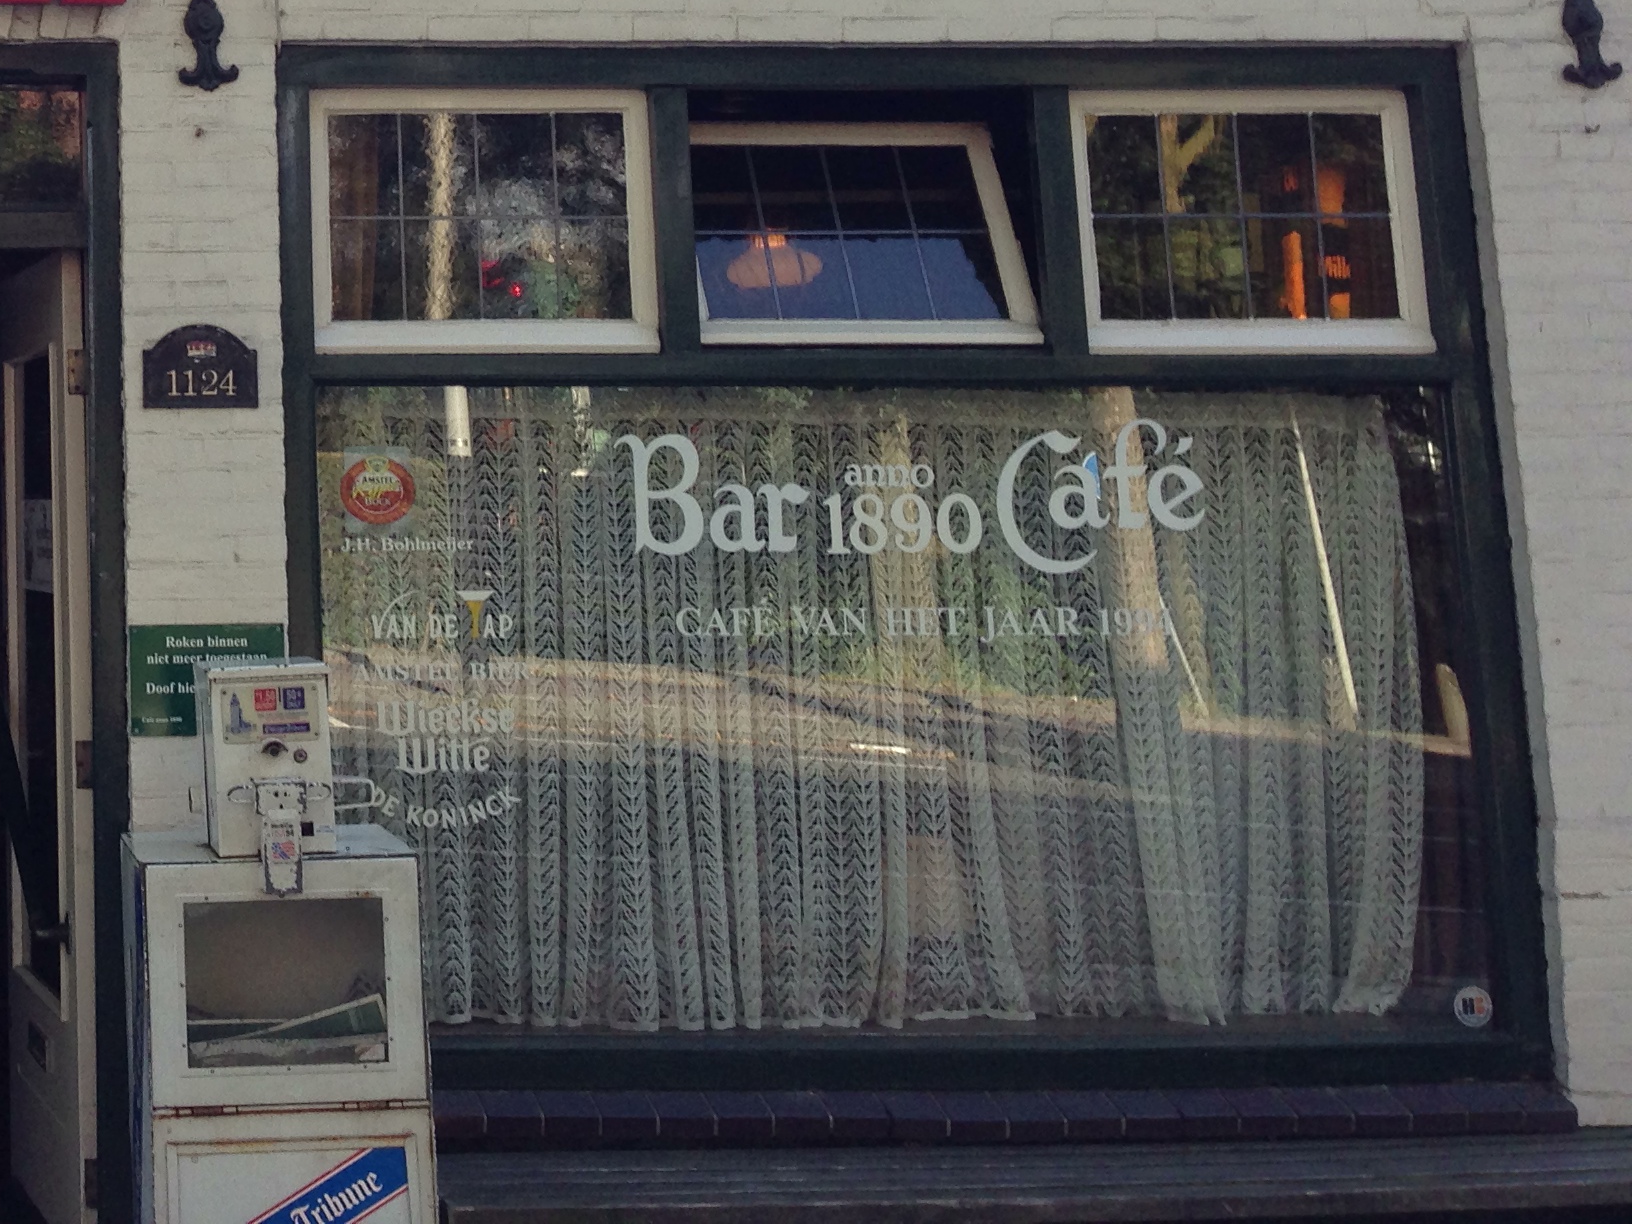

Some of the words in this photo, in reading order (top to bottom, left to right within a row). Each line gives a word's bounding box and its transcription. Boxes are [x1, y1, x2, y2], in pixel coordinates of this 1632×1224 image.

[166, 369, 237, 396] 1124
[362, 476, 393, 484] AMSTEL
[843, 461, 935, 488] anno
[613, 433, 811, 557] Bar
[996, 418, 1207, 575] Café
[825, 493, 983, 555] 1890
[165, 636, 204, 648] Roken
[207, 636, 248, 648] binnen
[371, 612, 417, 639] VAN
[429, 614, 459, 639] DE
[791, 606, 867, 637] VAN
[886, 606, 966, 636] HET
[980, 606, 1082, 643] JAAR
[146, 653, 169, 664] niet
[172, 655, 203, 664] meer
[146, 682, 176, 694] Doof
[375, 698, 515, 736] Wieckse
[395, 737, 491, 775] Witte
[373, 786, 400, 817] DE
[406, 785, 522, 829] KONINCK
[290, 1171, 383, 1224] Tribune
